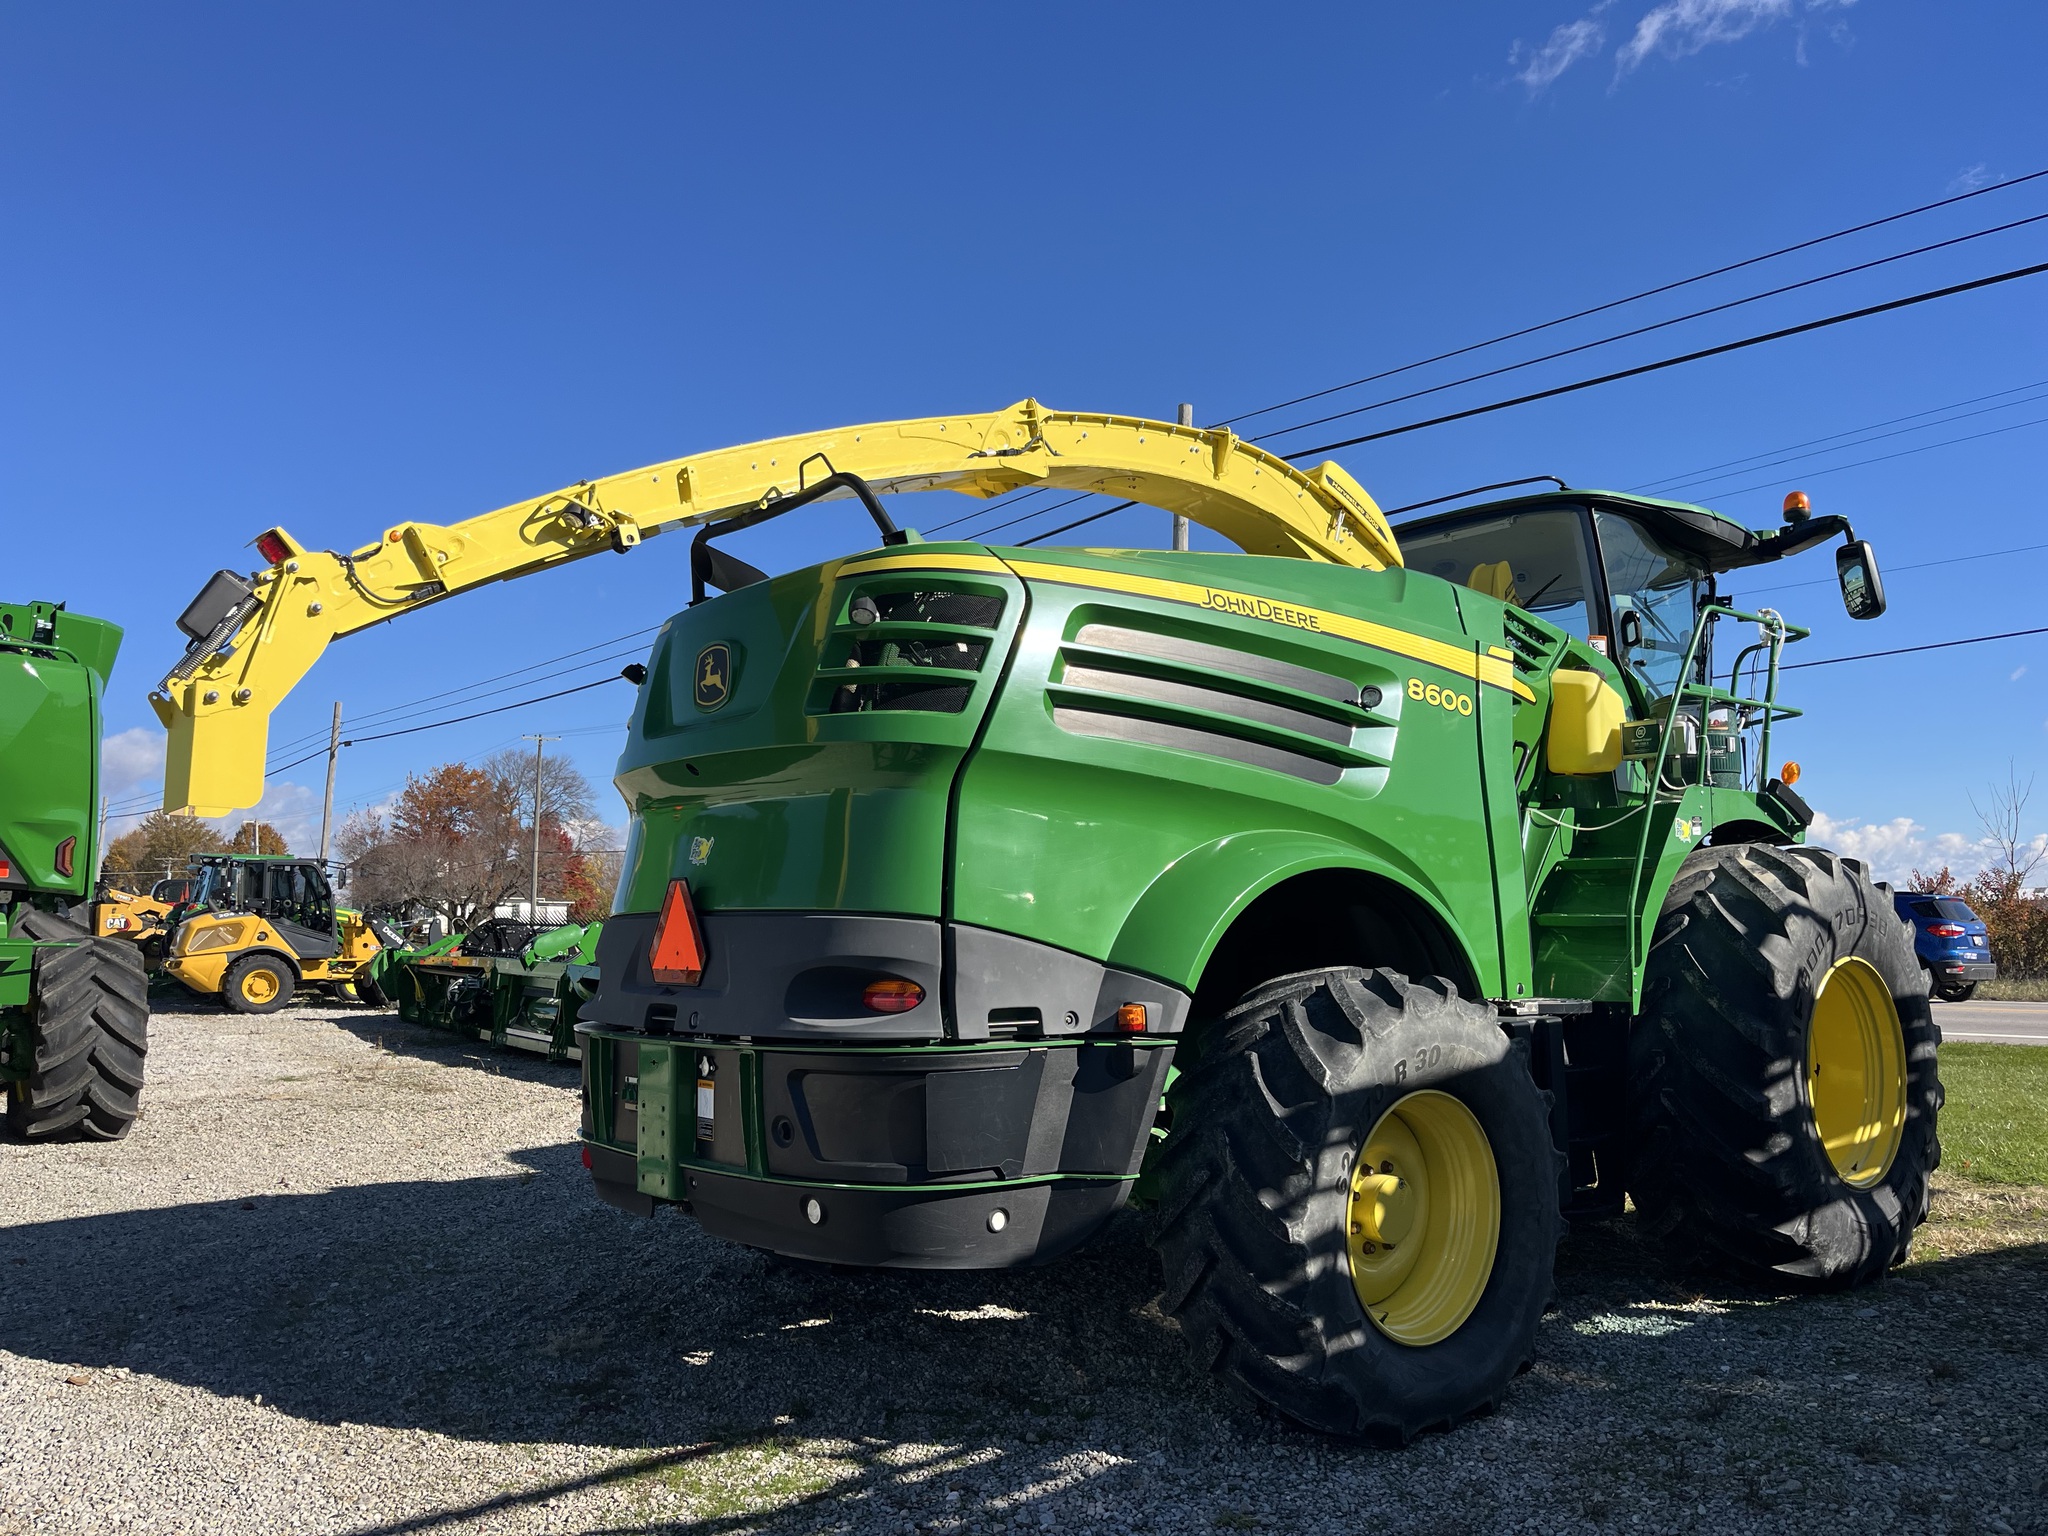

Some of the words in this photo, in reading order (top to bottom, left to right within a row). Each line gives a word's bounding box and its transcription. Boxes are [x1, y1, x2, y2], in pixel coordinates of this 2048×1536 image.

[1331, 480, 1366, 515] HarvestLab
[1201, 589, 1255, 616] JOHN
[1257, 600, 1320, 630] DEERE
[1407, 677, 1473, 717] 8600
[106, 918, 127, 929] CAT
[382, 926, 404, 945] DEERE
[1414, 1044, 1442, 1073] 30
